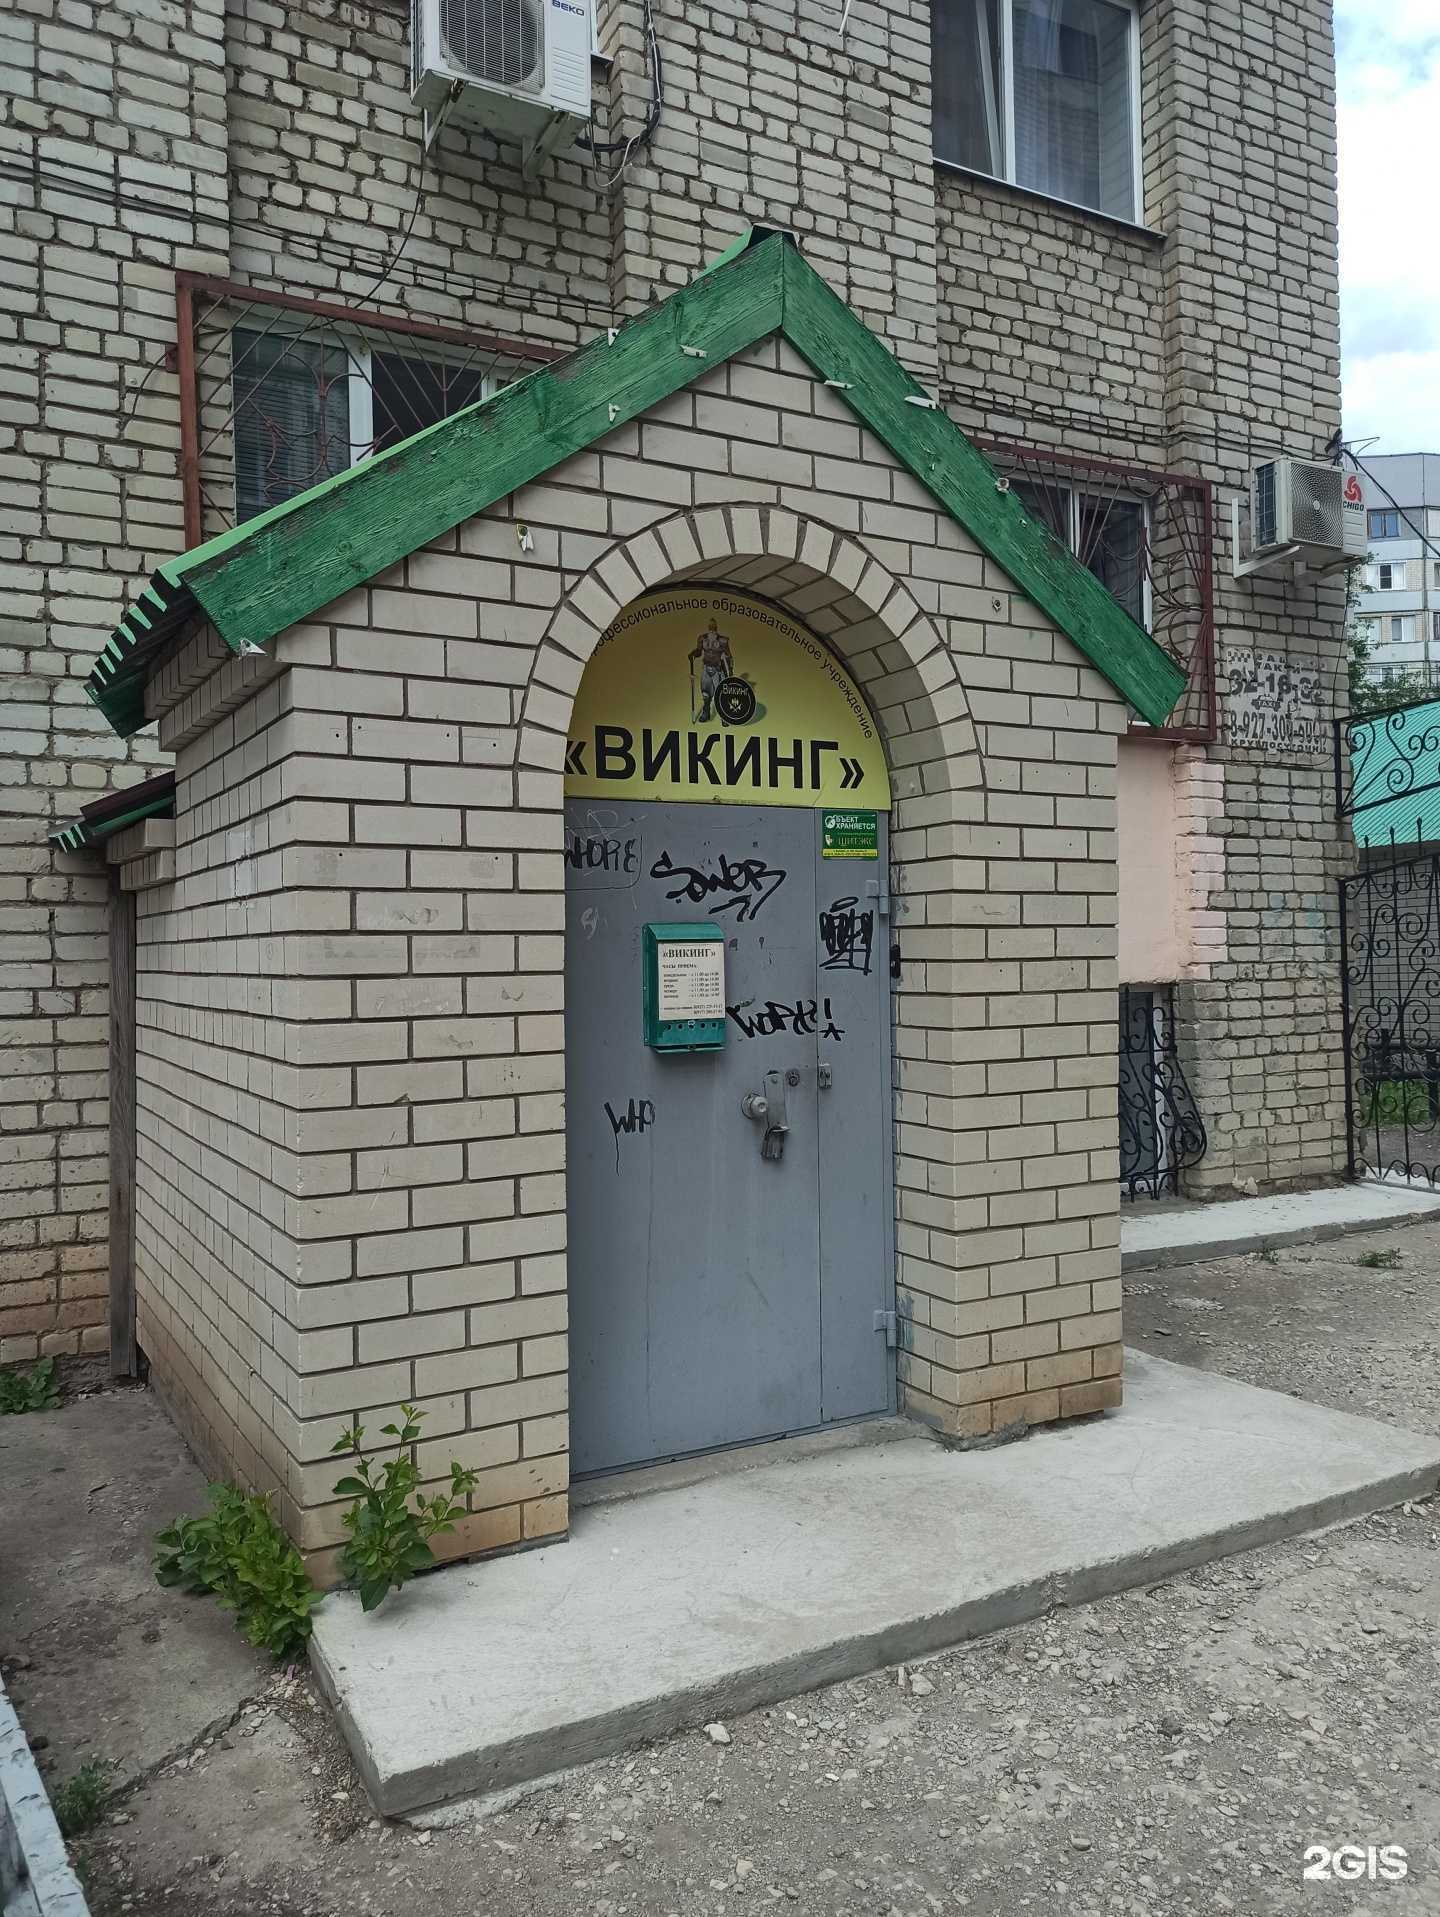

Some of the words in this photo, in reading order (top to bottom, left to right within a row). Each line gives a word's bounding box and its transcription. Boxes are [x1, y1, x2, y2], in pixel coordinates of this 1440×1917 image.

[552, 0, 584, 16] BEKO
[1343, 501, 1365, 512] CHIGO
[712, 598, 821, 660] образовательное
[821, 658, 873, 739] учреждение
[564, 725, 864, 790] «ВИКИНГ»
